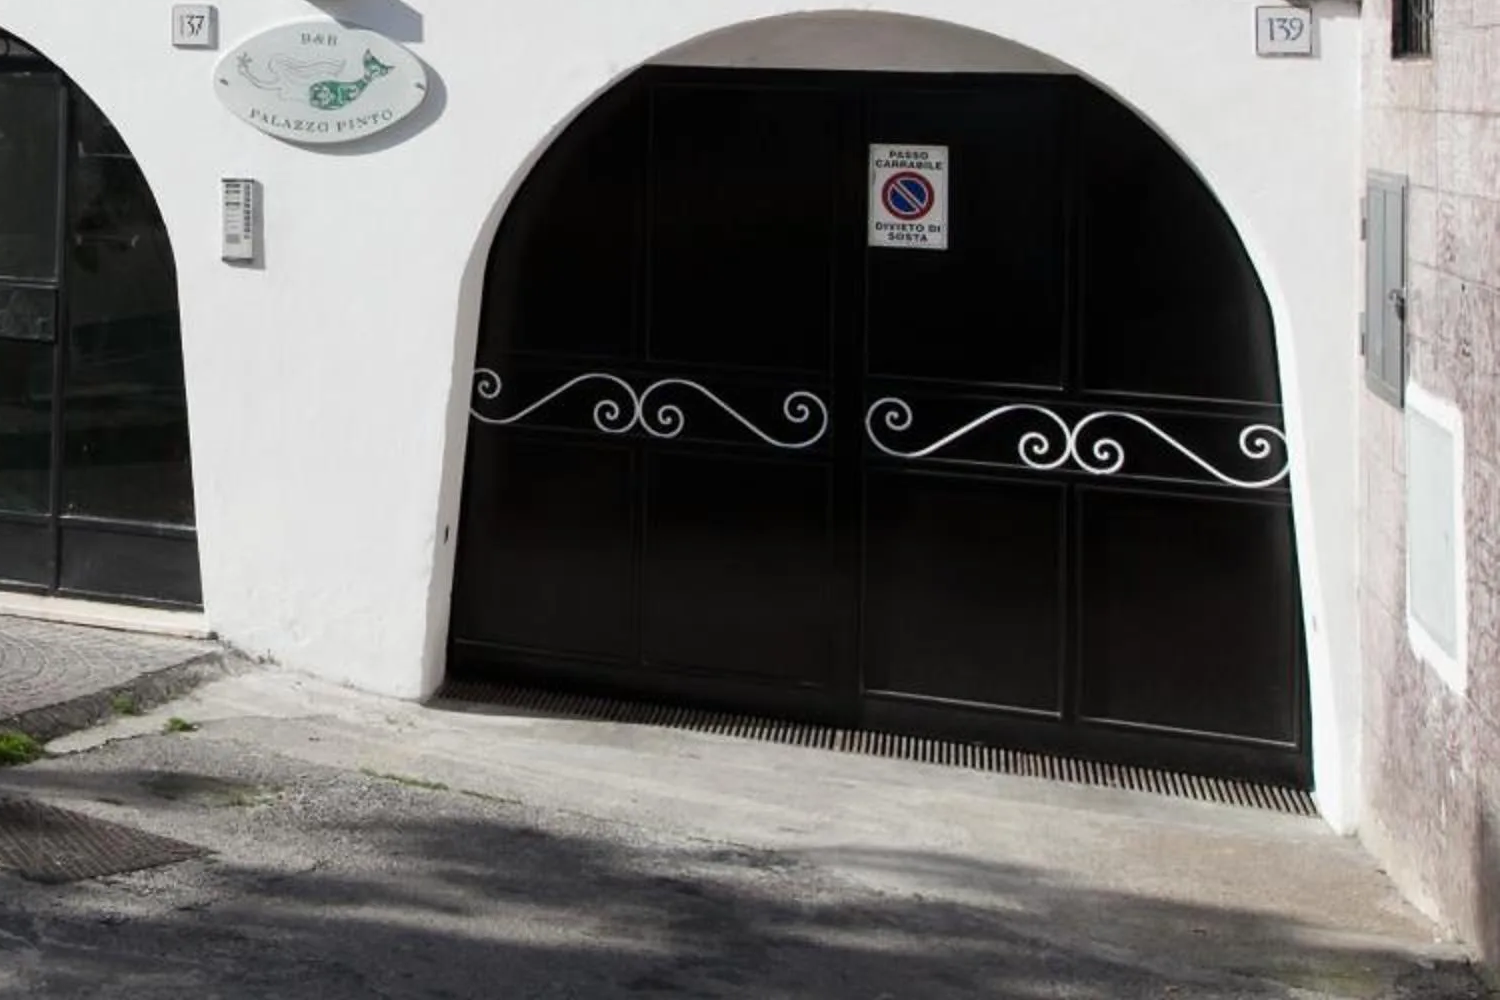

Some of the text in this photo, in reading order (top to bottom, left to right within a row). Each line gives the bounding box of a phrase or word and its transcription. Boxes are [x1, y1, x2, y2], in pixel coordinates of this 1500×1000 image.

[178, 13, 206, 39] 137
[1267, 17, 1305, 41] 139
[300, 32, 339, 47] B&B
[250, 108, 394, 133] PALAZZO PINTO
[889, 150, 929, 160] PASSO
[875, 159, 942, 170] CARRABILE
[875, 221, 941, 233] DIVIETO DI
[887, 231, 928, 242] SOSTA
